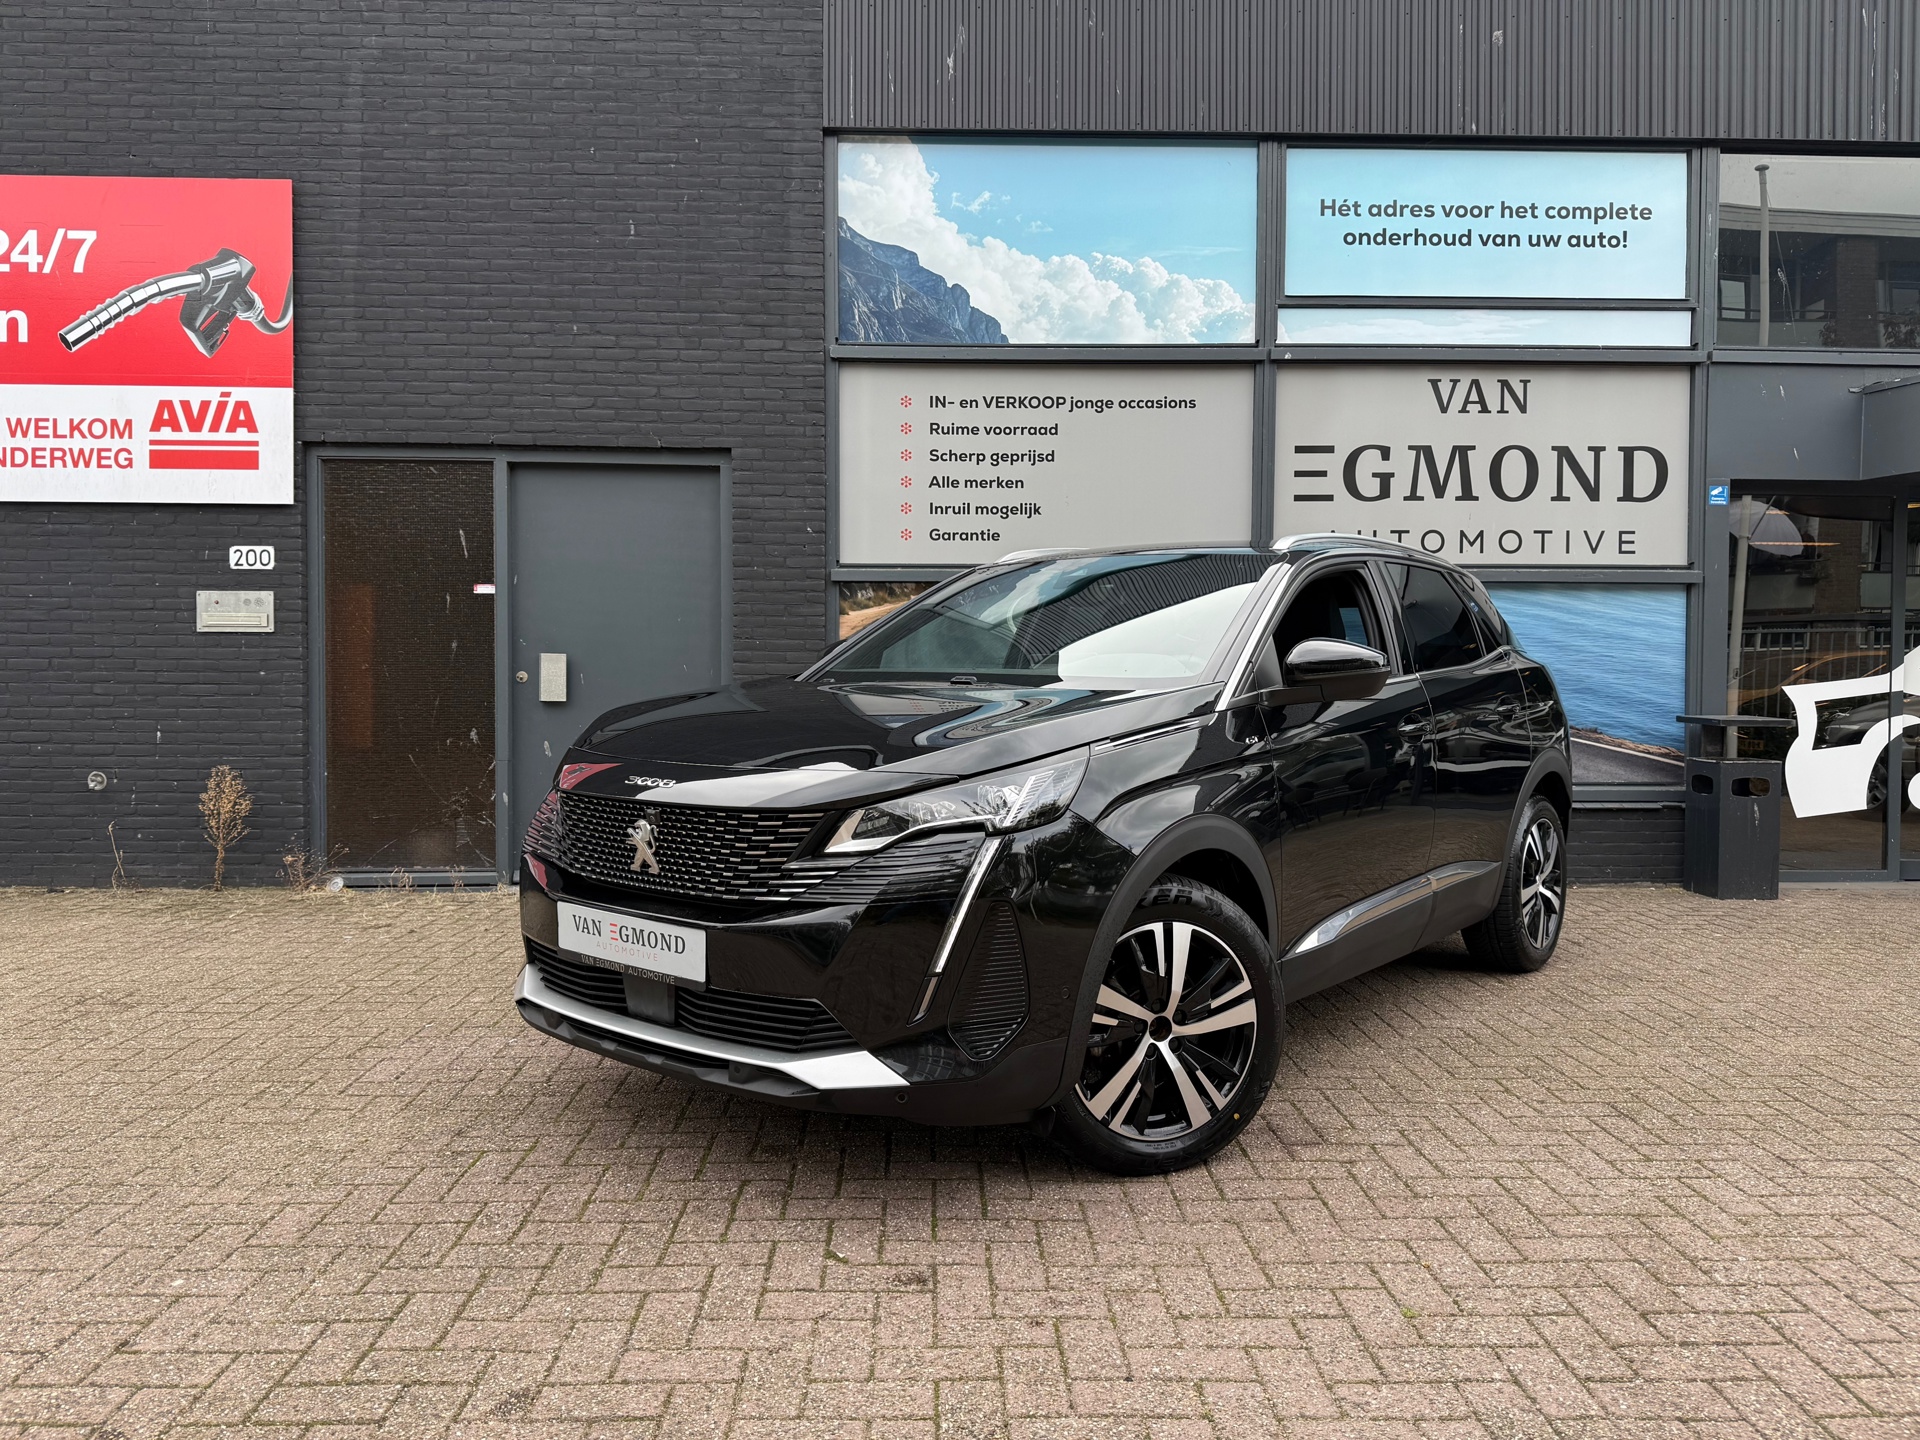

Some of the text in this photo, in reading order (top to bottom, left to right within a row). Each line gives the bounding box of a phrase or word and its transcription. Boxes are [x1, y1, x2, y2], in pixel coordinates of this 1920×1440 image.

[1320, 198, 1653, 225] Hét adres voor het complete
[1342, 228, 1628, 249] onderhoud van uw auto!
[929, 395, 1197, 414] IN- en VERKOOP jonge occasions
[1427, 378, 1531, 414] VAN
[5, 417, 133, 440] WELKOM
[929, 422, 1059, 436] Ruime voorraad
[929, 449, 1055, 467] Scherp geprijsd
[928, 475, 1025, 489] Alle merken
[929, 502, 1042, 520] Inruil mogelijk
[929, 528, 1001, 542] Garantie
[1330, 529, 1637, 555] TOMOTIVE
[233, 548, 271, 567] 200
[572, 914, 602, 937] VAN
[596, 941, 658, 962] AUTOMOTIVE
[581, 954, 594, 965] VAN
[628, 966, 675, 985] AUTOMOTIVE
